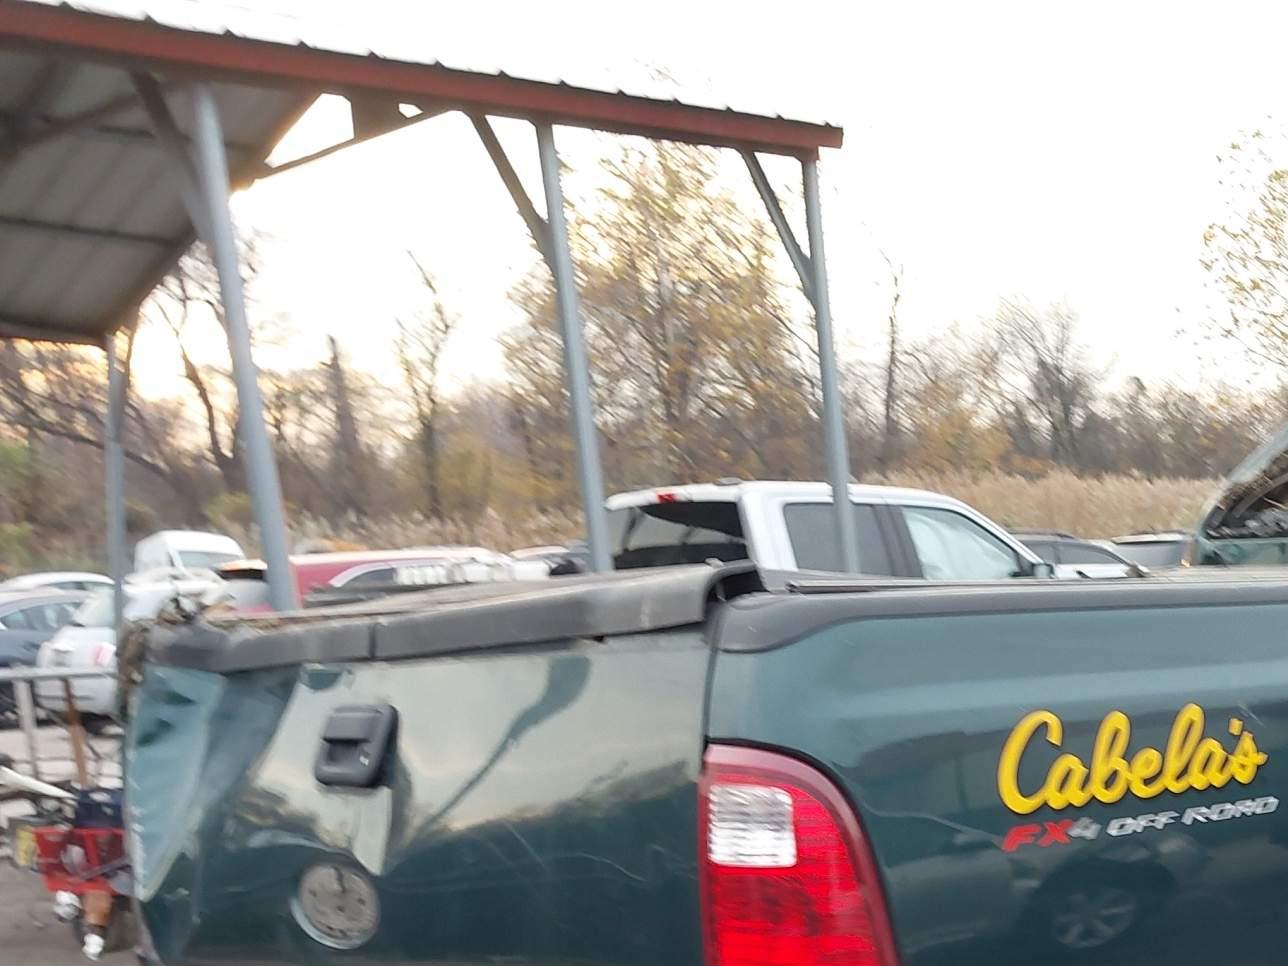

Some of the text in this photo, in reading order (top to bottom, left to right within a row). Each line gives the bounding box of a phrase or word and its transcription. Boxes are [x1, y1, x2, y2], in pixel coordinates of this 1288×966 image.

[997, 702, 1269, 815] Cabela's
[1002, 795, 1279, 853] FX4 OFF ROAD
